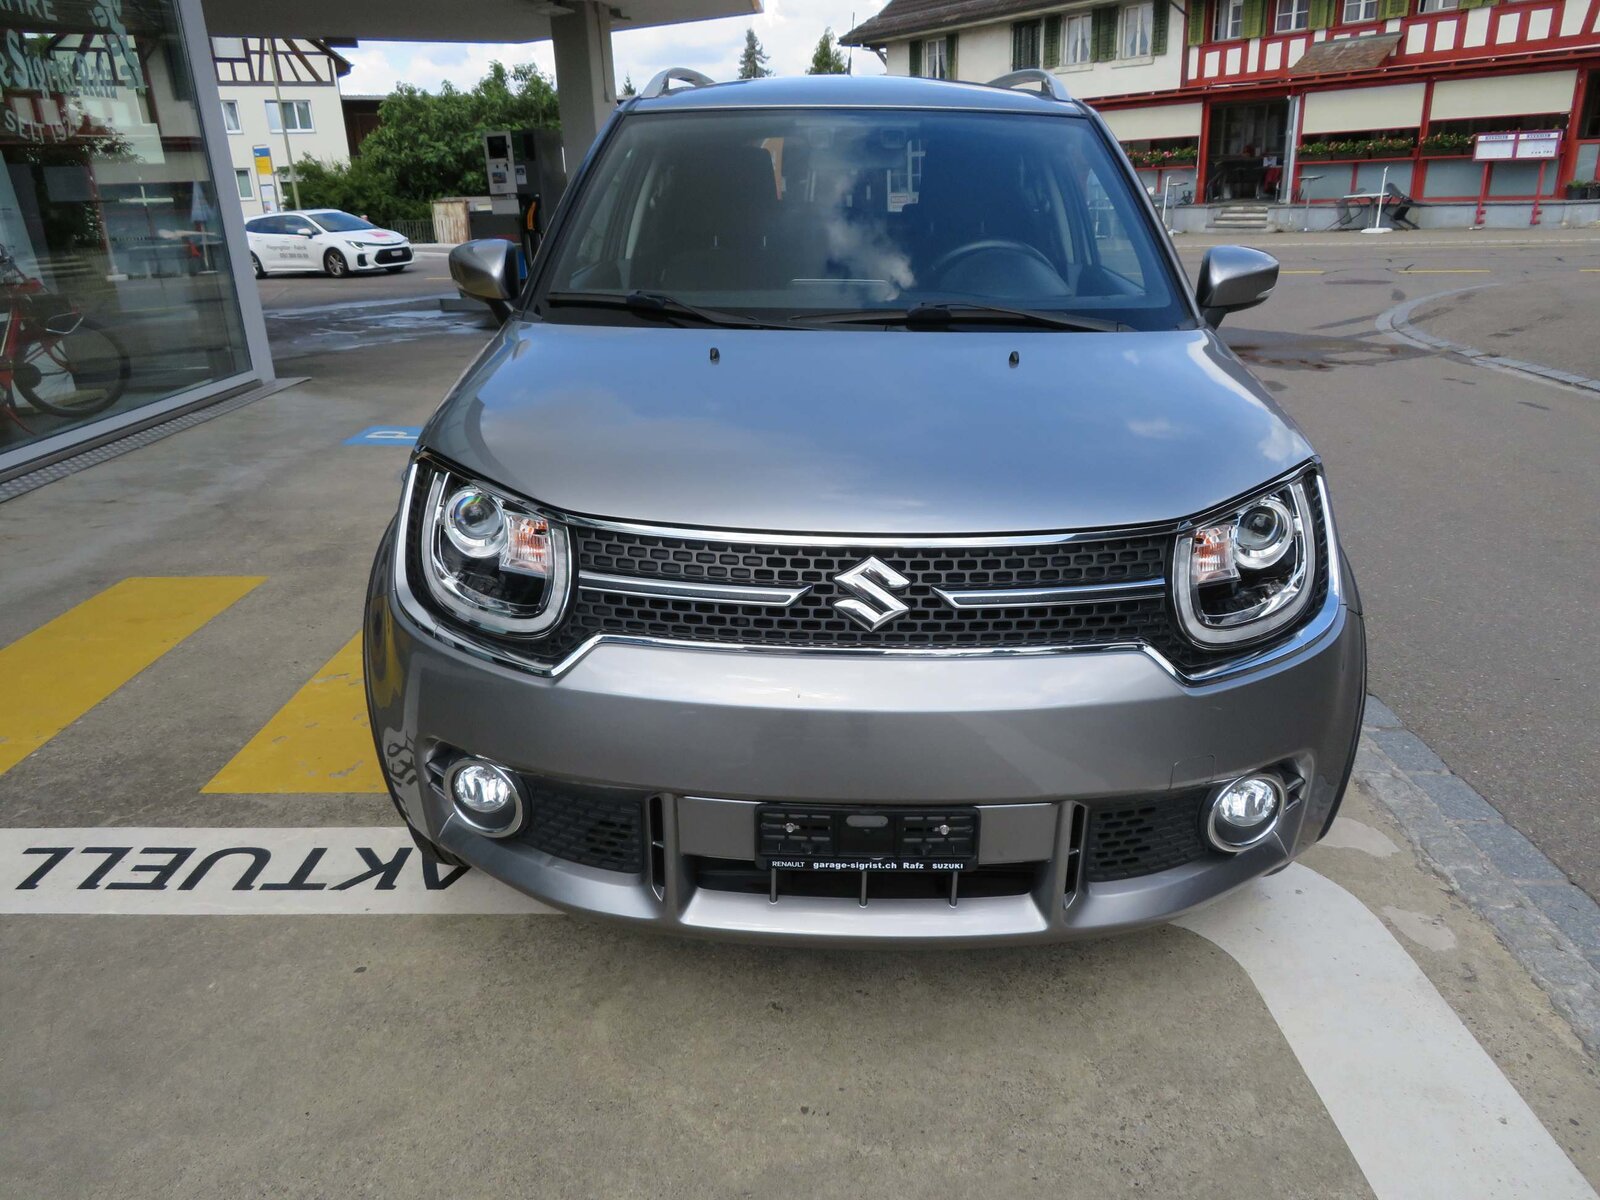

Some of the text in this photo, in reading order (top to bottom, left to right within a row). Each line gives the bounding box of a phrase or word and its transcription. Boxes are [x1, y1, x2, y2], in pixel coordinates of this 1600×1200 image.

[812, 861, 898, 870] garage-sigrist.ch
[902, 862, 925, 870] Rafz
[932, 862, 964, 870] SUZUKI
